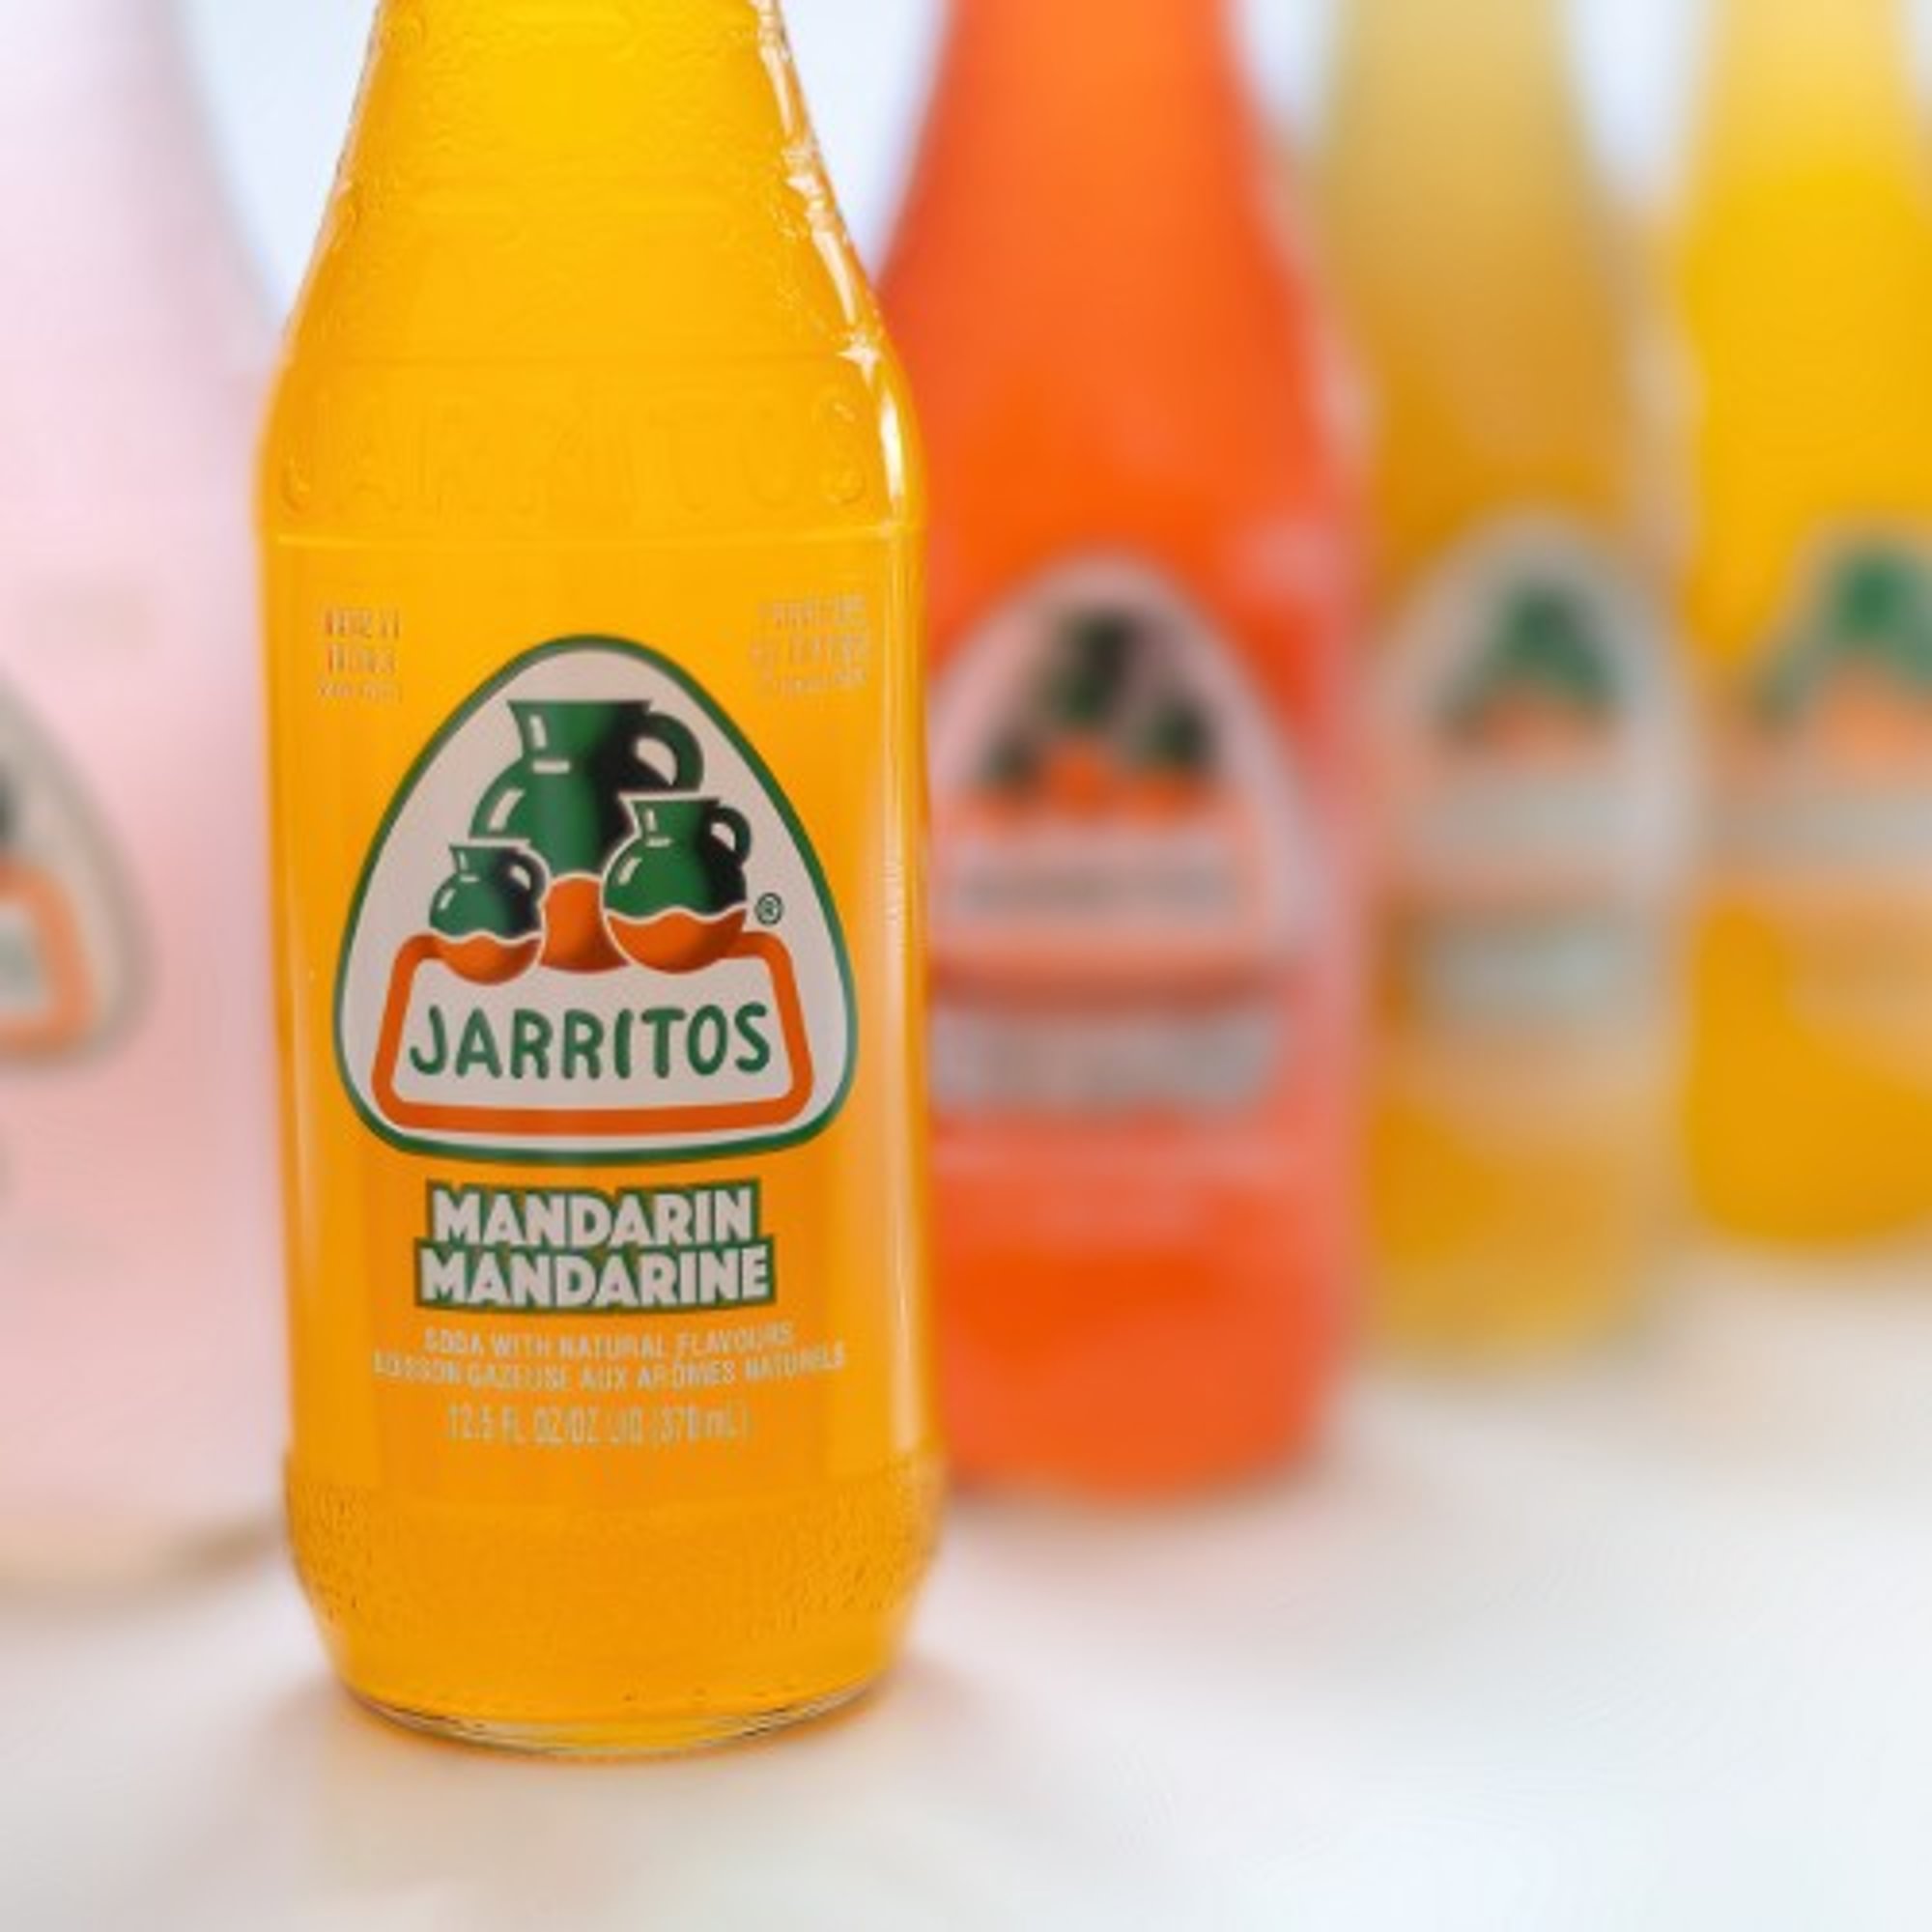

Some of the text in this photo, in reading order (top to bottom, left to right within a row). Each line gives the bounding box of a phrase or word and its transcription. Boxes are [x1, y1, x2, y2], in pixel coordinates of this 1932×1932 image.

[409, 1002, 771, 1080] JARRITOS
[431, 1186, 753, 1247] MANDARIN
[418, 1245, 770, 1307] MANDARINE
[490, 1330, 551, 1358] WITH
